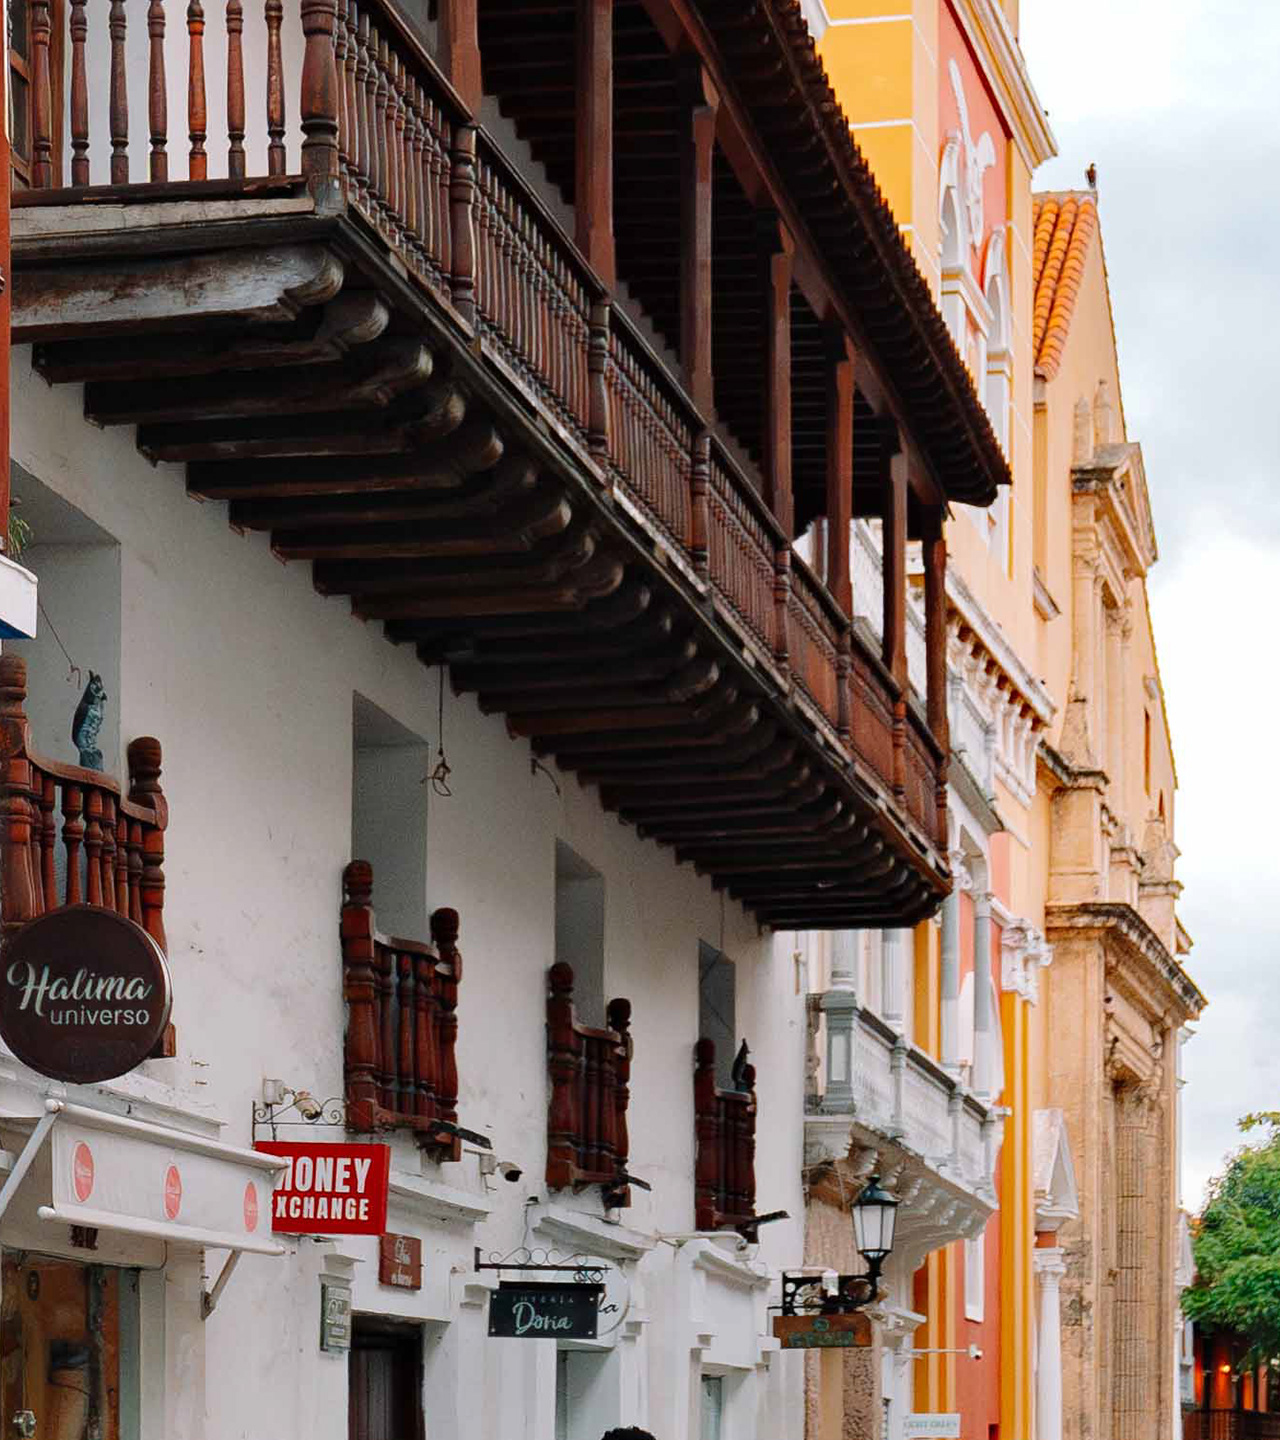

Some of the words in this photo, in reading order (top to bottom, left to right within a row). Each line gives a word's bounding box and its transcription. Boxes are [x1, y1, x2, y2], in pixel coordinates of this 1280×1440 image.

[6, 960, 153, 1017] Halima
[50, 1005, 150, 1026] universo
[271, 1195, 370, 1221] XCHANGE
